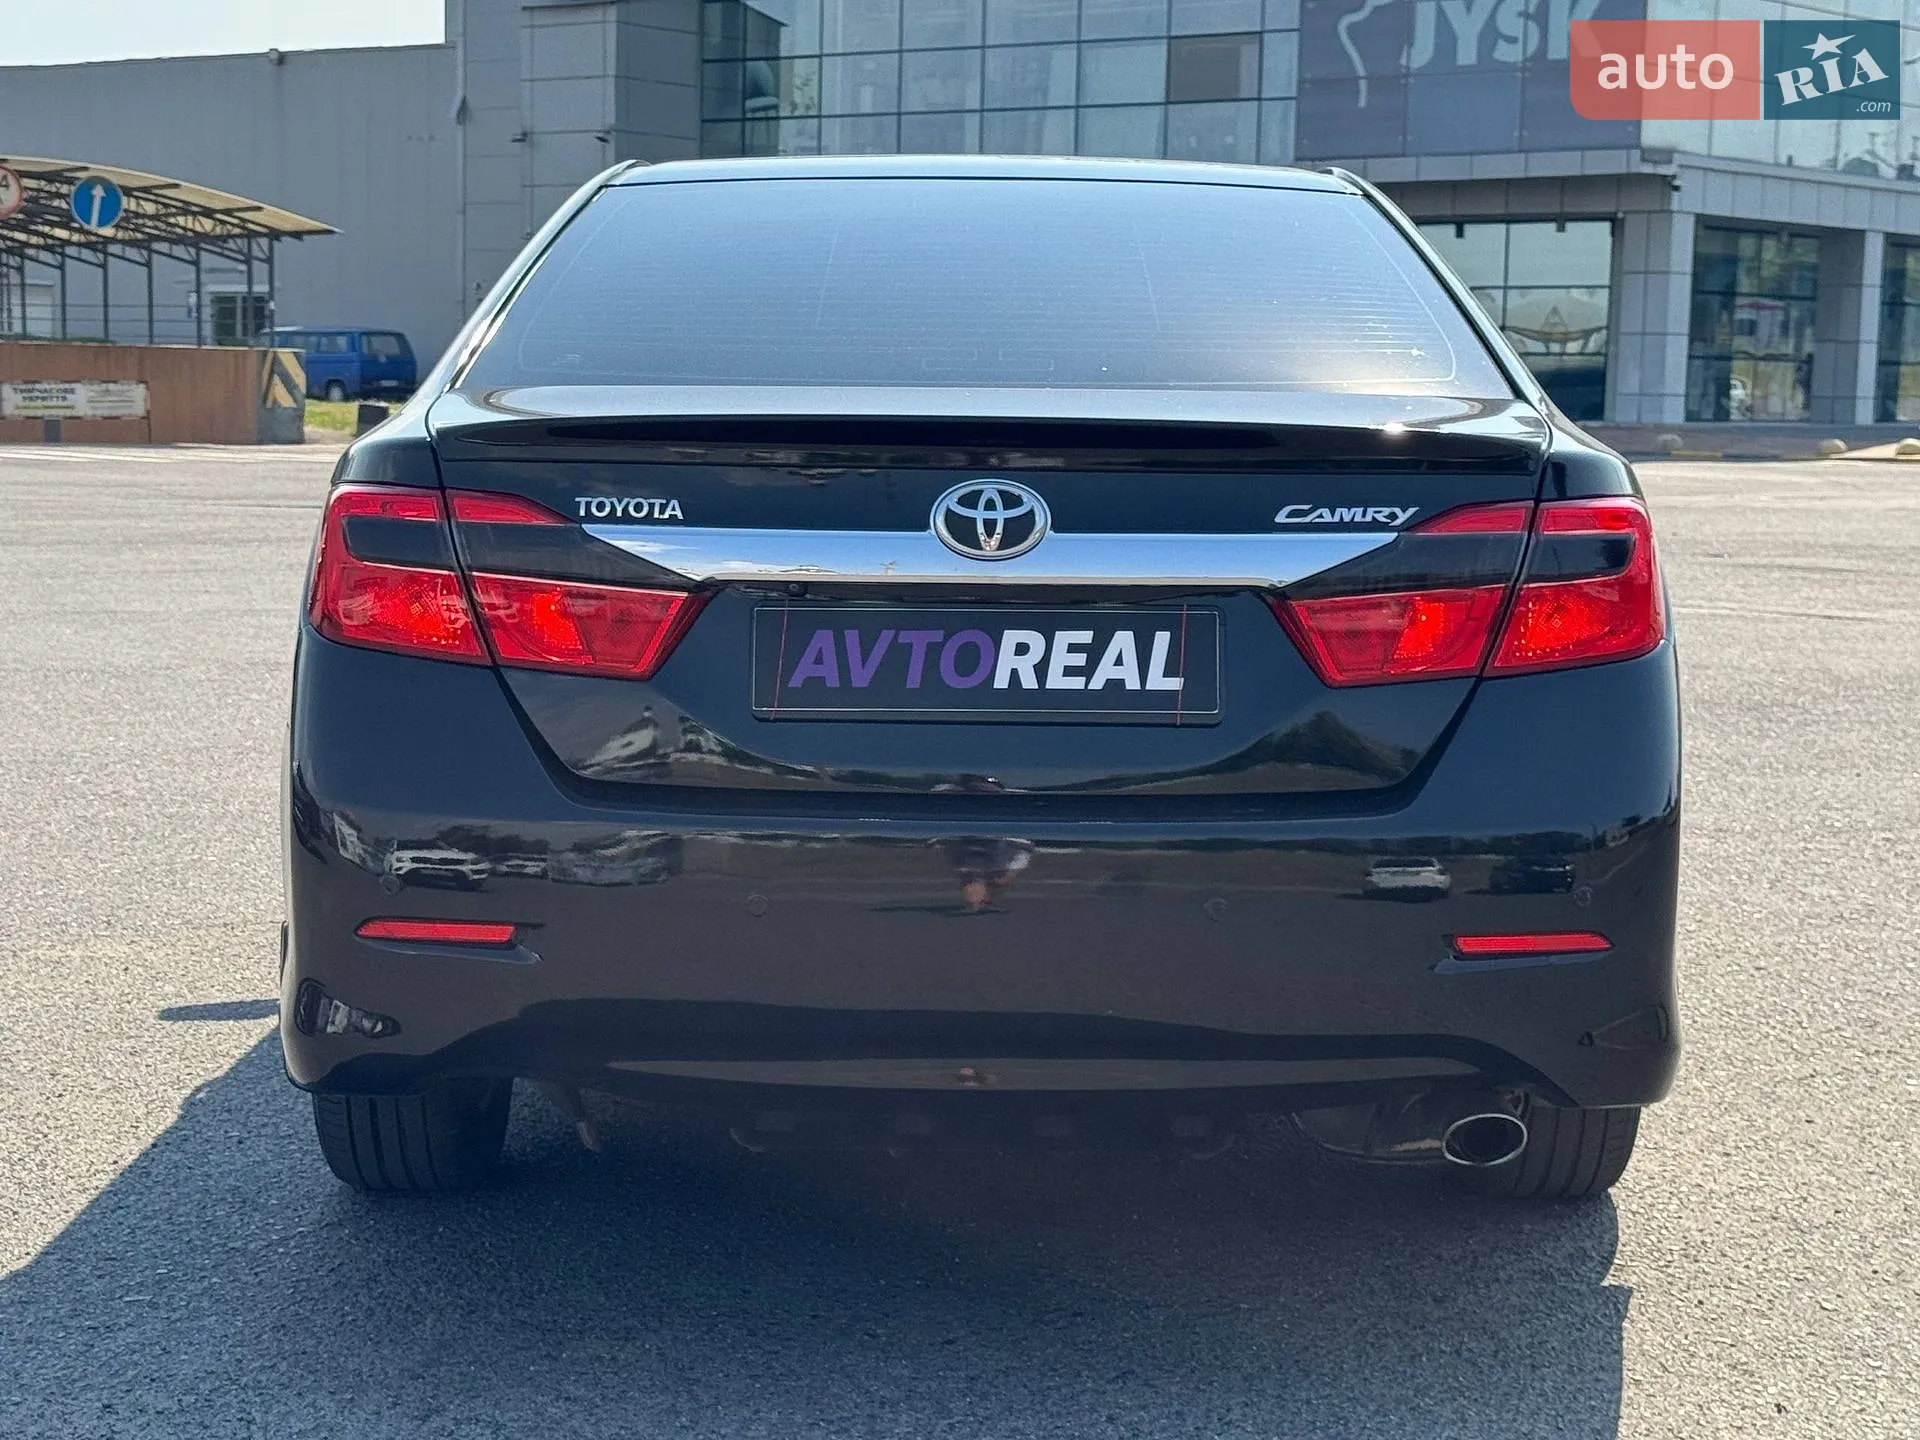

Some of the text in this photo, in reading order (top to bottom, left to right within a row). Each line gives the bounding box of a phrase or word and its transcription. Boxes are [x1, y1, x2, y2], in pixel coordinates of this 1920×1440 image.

[1400, 0, 1606, 69] JYSK
[574, 497, 684, 520] TOYOTA
[1274, 504, 1420, 527] CAMRY
[787, 629, 1185, 691] AVTOREAL
